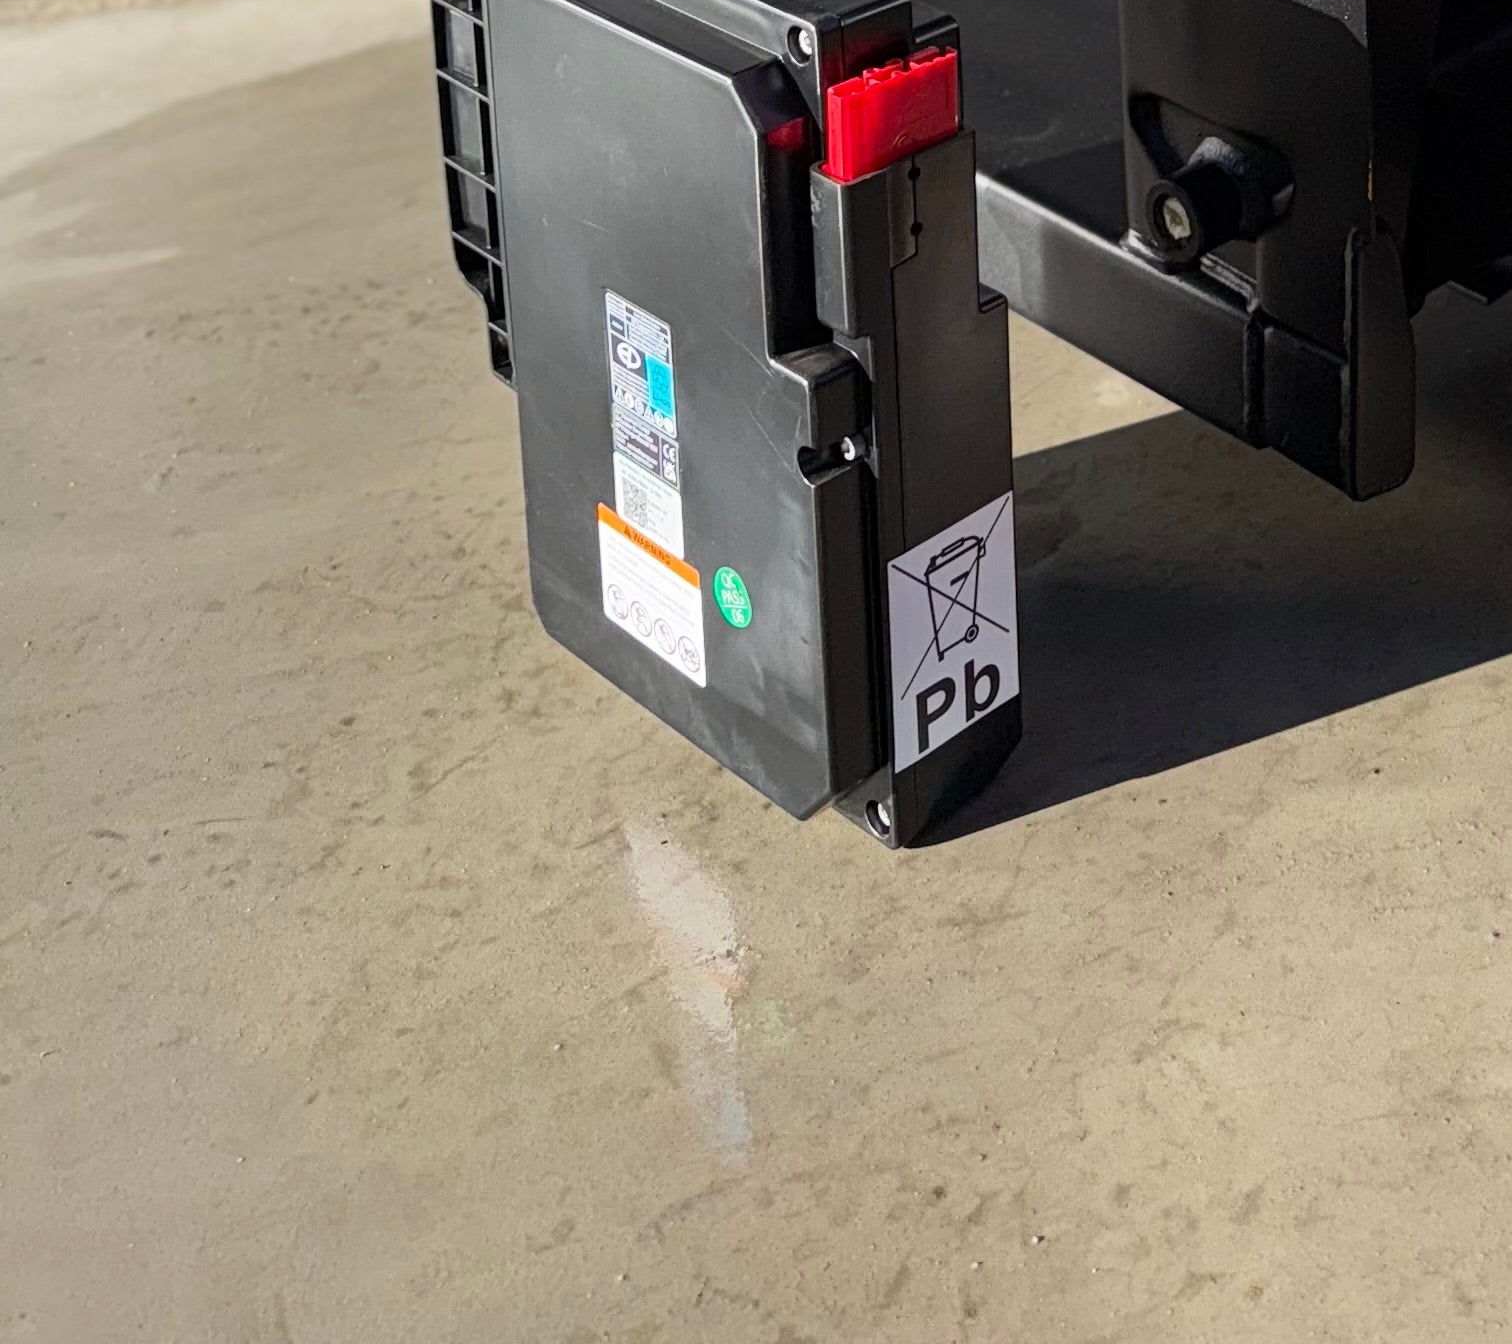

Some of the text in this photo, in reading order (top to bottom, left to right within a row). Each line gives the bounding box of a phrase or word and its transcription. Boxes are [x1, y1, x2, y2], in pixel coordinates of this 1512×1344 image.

[631, 529, 671, 566] WARNING
[720, 573, 736, 589] QC
[720, 589, 746, 606] PASS
[916, 658, 1000, 755] Pb
